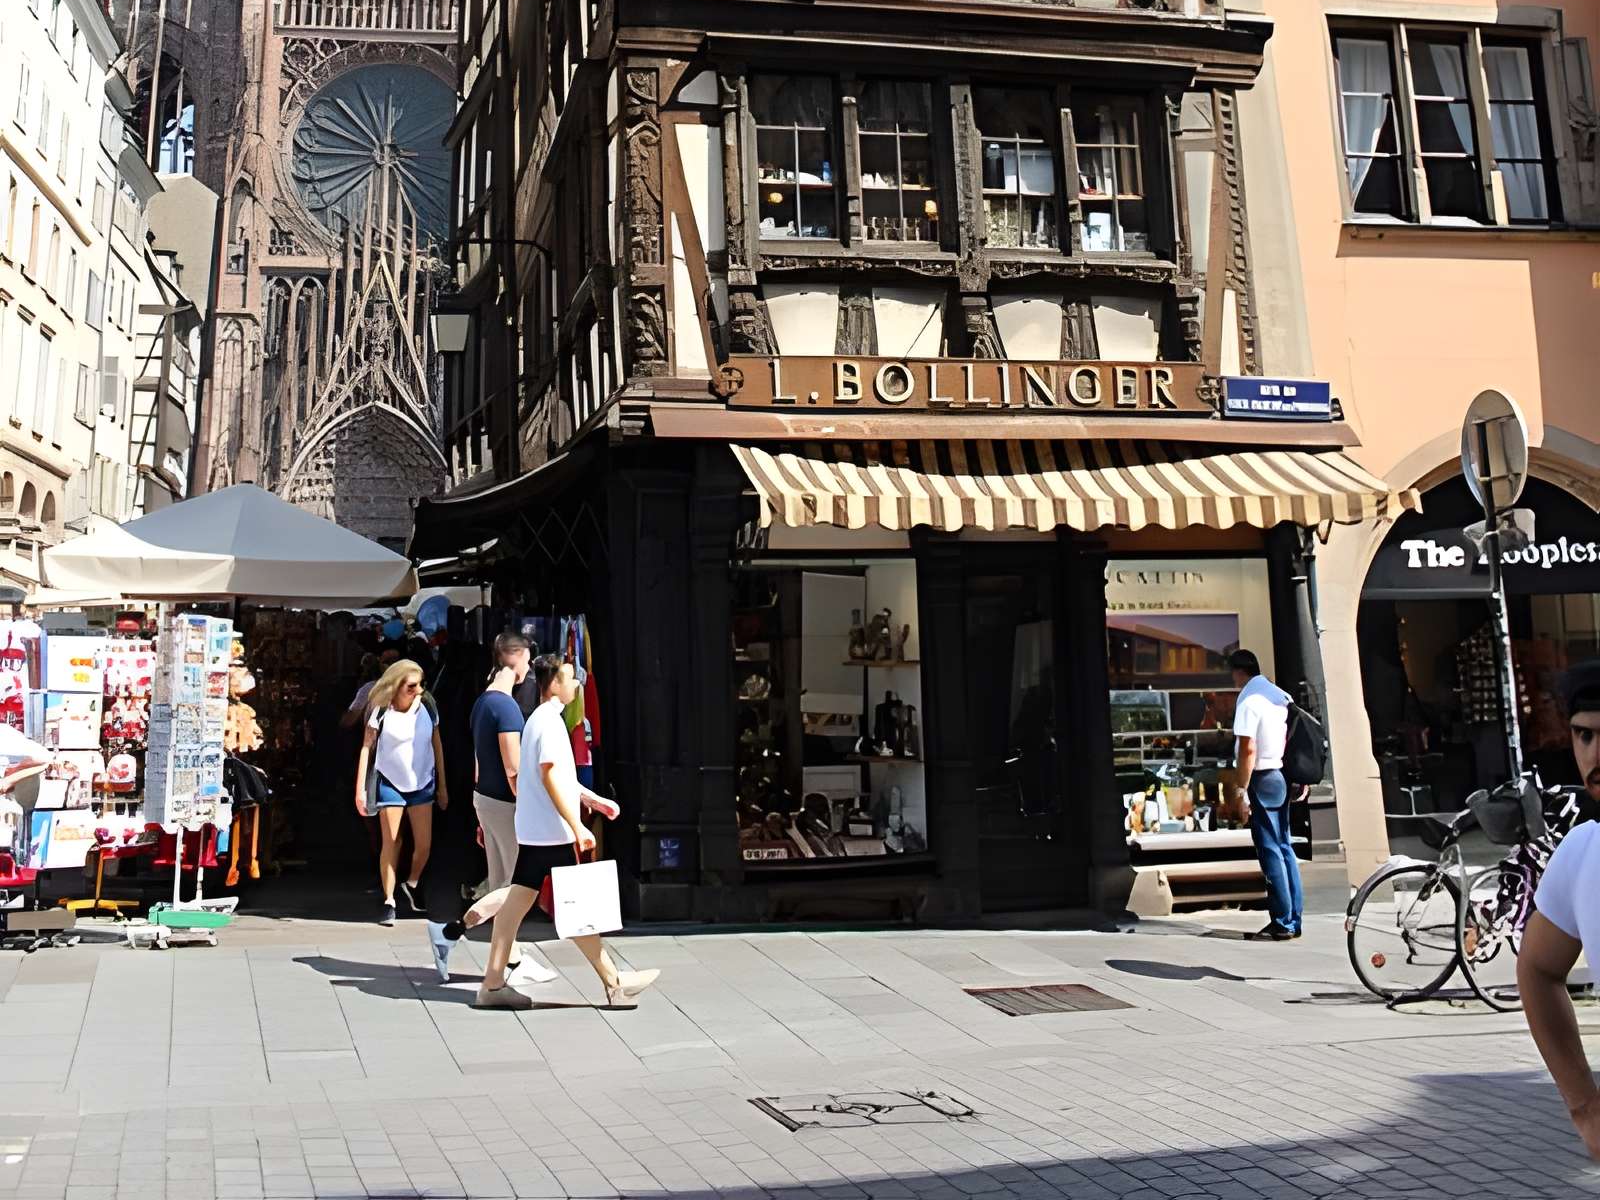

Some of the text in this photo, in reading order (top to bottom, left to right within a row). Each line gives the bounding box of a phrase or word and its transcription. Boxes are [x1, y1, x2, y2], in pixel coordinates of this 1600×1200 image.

[771, 358, 1178, 408] L. BOLLINGER
[1401, 536, 1600, 568] The ooples
